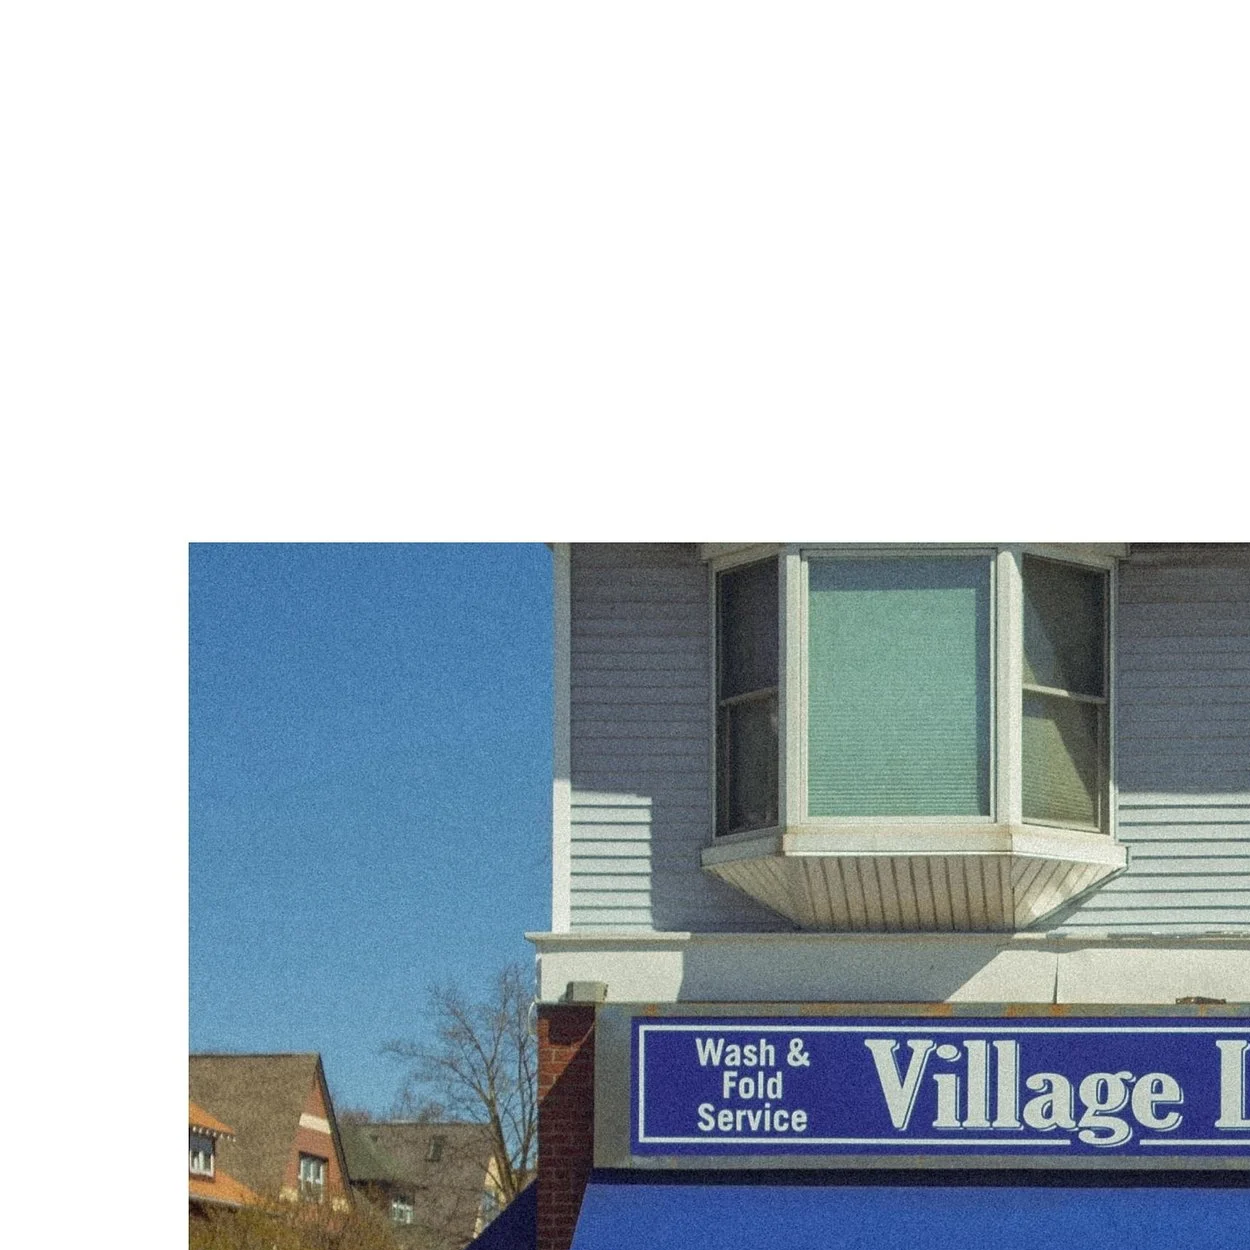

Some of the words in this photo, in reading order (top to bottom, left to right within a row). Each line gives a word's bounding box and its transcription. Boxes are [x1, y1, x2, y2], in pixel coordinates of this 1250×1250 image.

[695, 1037, 775, 1067] Wash
[786, 1037, 811, 1067] &
[722, 1070, 783, 1100] Fold
[864, 1038, 1184, 1148] Village
[697, 1102, 808, 1132] Service
